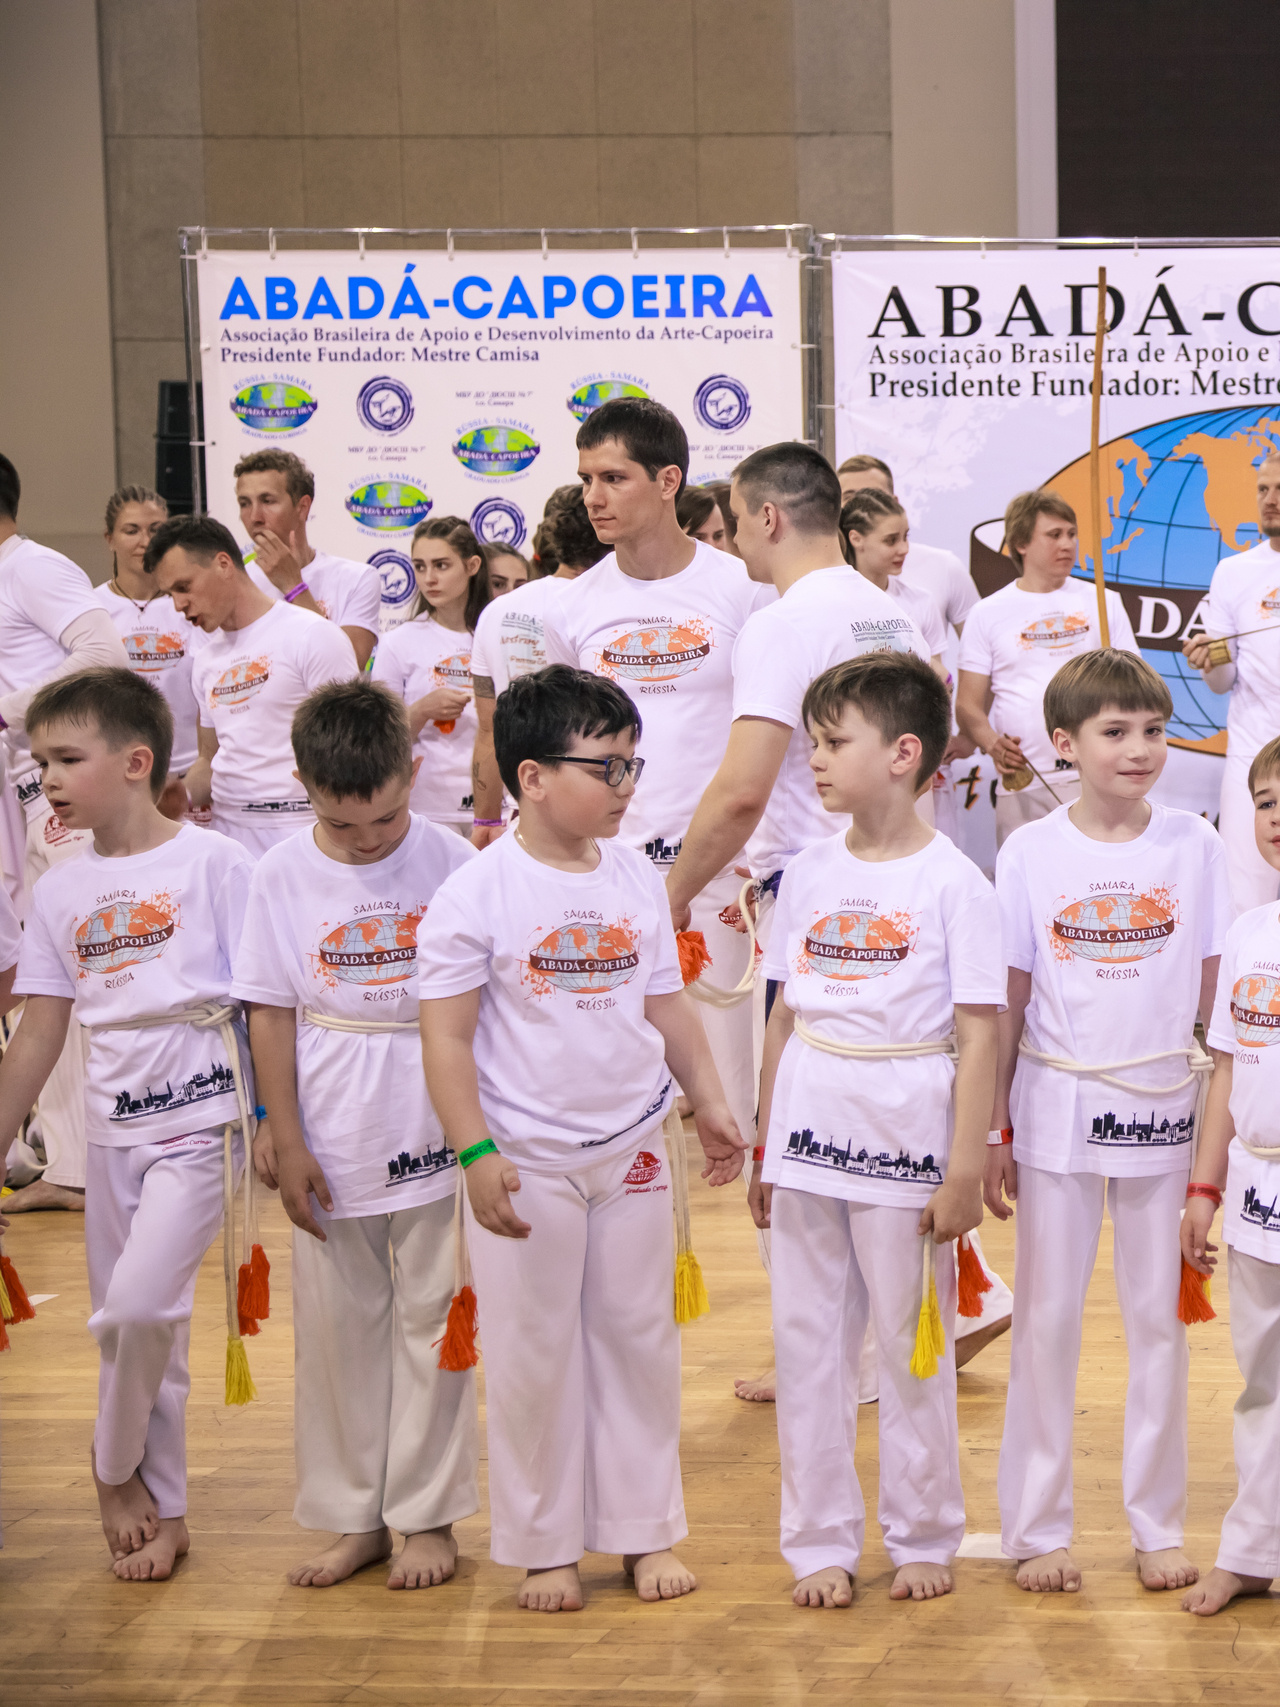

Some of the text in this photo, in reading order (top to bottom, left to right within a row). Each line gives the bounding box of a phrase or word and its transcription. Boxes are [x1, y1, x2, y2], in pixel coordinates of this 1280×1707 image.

[219, 262, 773, 320] ABADÁ-CAPOEIRA
[219, 324, 774, 345] Associação Brasileira de Apoio e Desenvolvimento da Arte-Capoeira
[220, 345, 540, 363] Presidente Fundador: Mestre Camisa
[868, 343, 1002, 369] Associação
[1011, 341, 1128, 364] Brasilera
[1138, 341, 1165, 363] de
[1175, 341, 1251, 368] Apoio
[1258, 347, 1270, 362] e
[868, 370, 1021, 398] Presidente
[637, 615, 673, 627] SAMARA
[607, 646, 705, 665] ABADÁ-CAPOEIRA
[639, 683, 677, 695] RÚSSIA
[1088, 881, 1135, 893] SAMARA
[353, 900, 401, 915] SAMARA
[838, 897, 878, 910] SAMARA
[1059, 924, 1169, 944] ABADÁ-CAPOEIRA
[80, 930, 168, 956] BADÁCAPOEIRA
[807, 940, 901, 960] ABADÁ-CAPOEIRA
[325, 947, 416, 964] ABADÁ-CAPOE
[1095, 966, 1140, 981] RÚSSIA
[362, 987, 408, 1002] RÚSSIA
[823, 983, 860, 996] RÚSSIA
